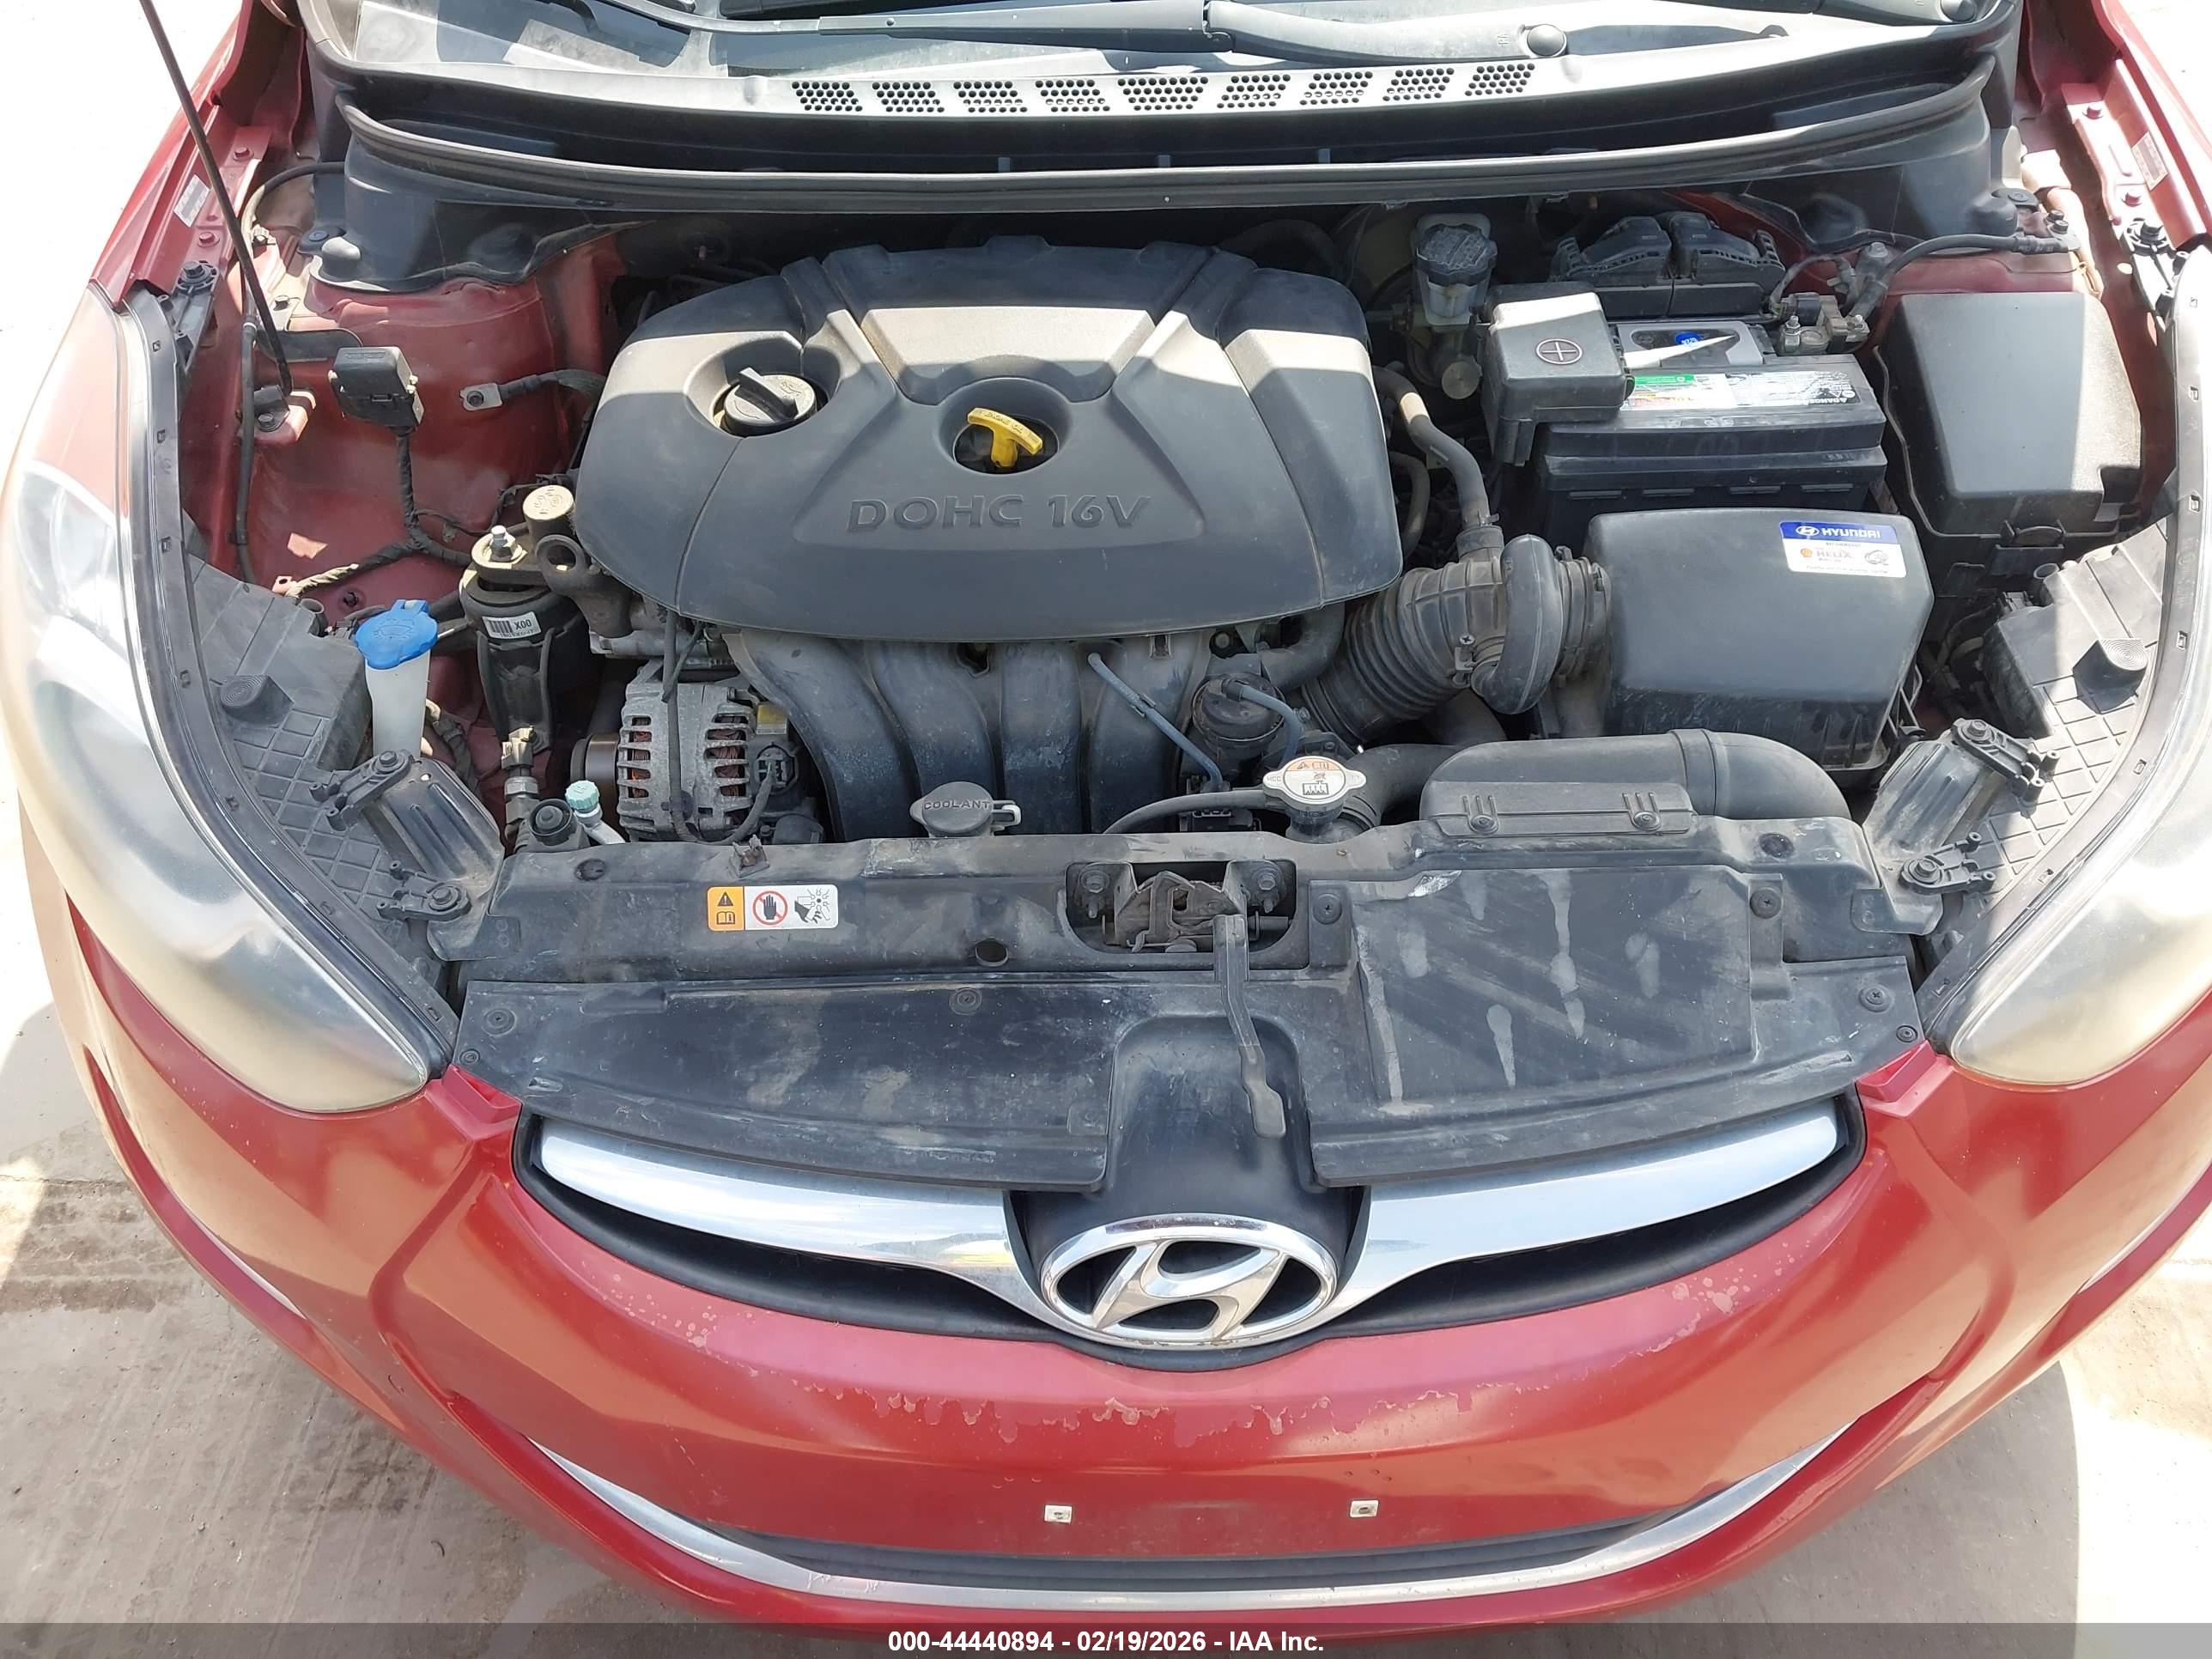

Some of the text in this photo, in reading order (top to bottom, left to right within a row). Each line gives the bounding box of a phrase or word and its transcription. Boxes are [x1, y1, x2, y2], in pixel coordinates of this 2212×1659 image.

[847, 495, 1152, 532] DOHC 16V
[1821, 527, 1881, 538] HYUNDAI
[923, 799, 991, 811] COOLANT
